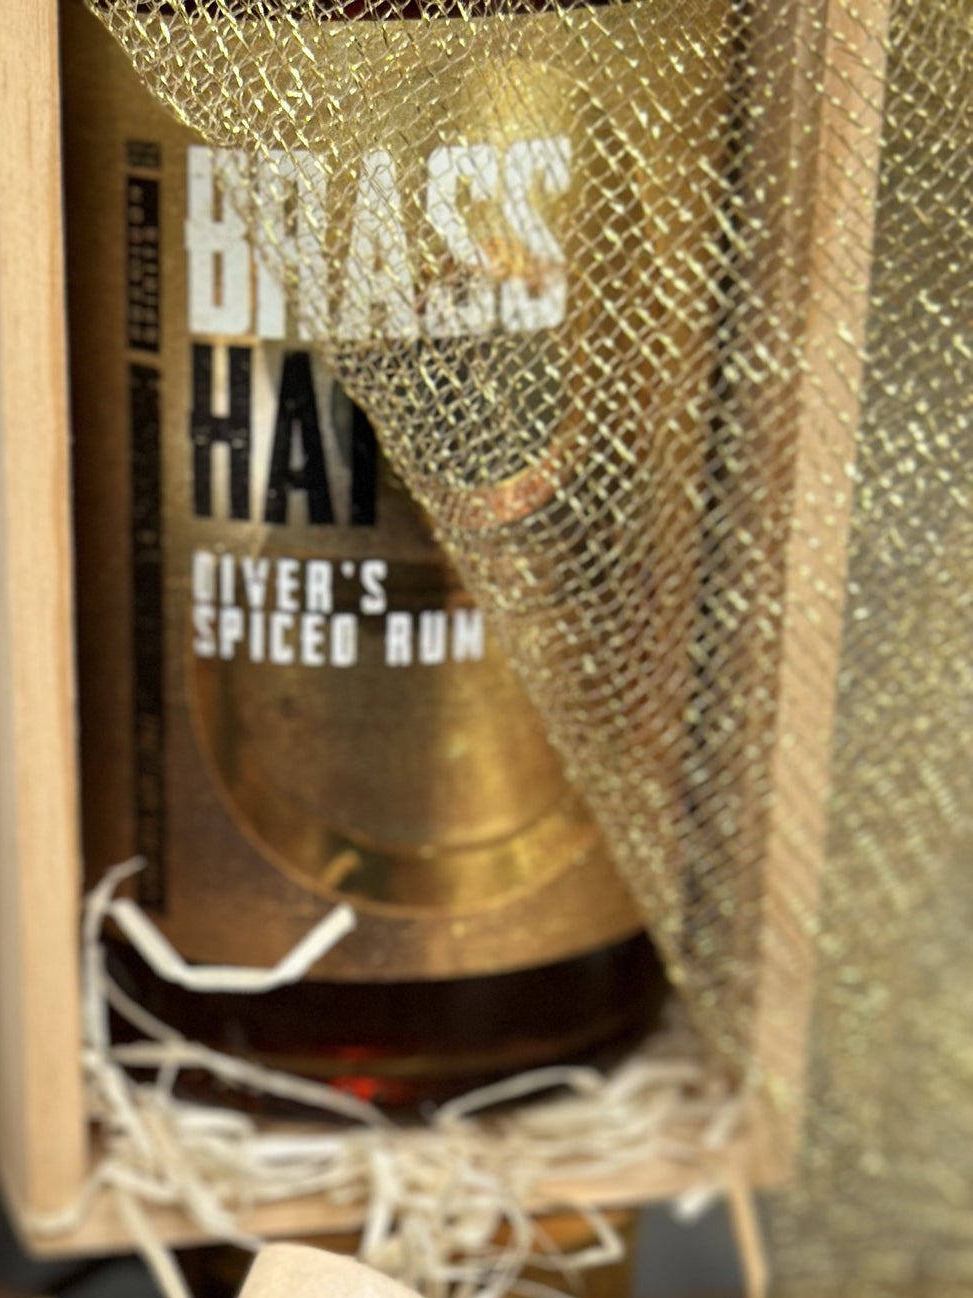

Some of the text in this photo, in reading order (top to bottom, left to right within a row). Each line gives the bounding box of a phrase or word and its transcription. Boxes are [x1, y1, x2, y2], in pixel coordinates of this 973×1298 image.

[185, 137, 572, 340] BRASS
[191, 549, 388, 615] DIVER'S
[191, 604, 485, 667] SPICED RUM
